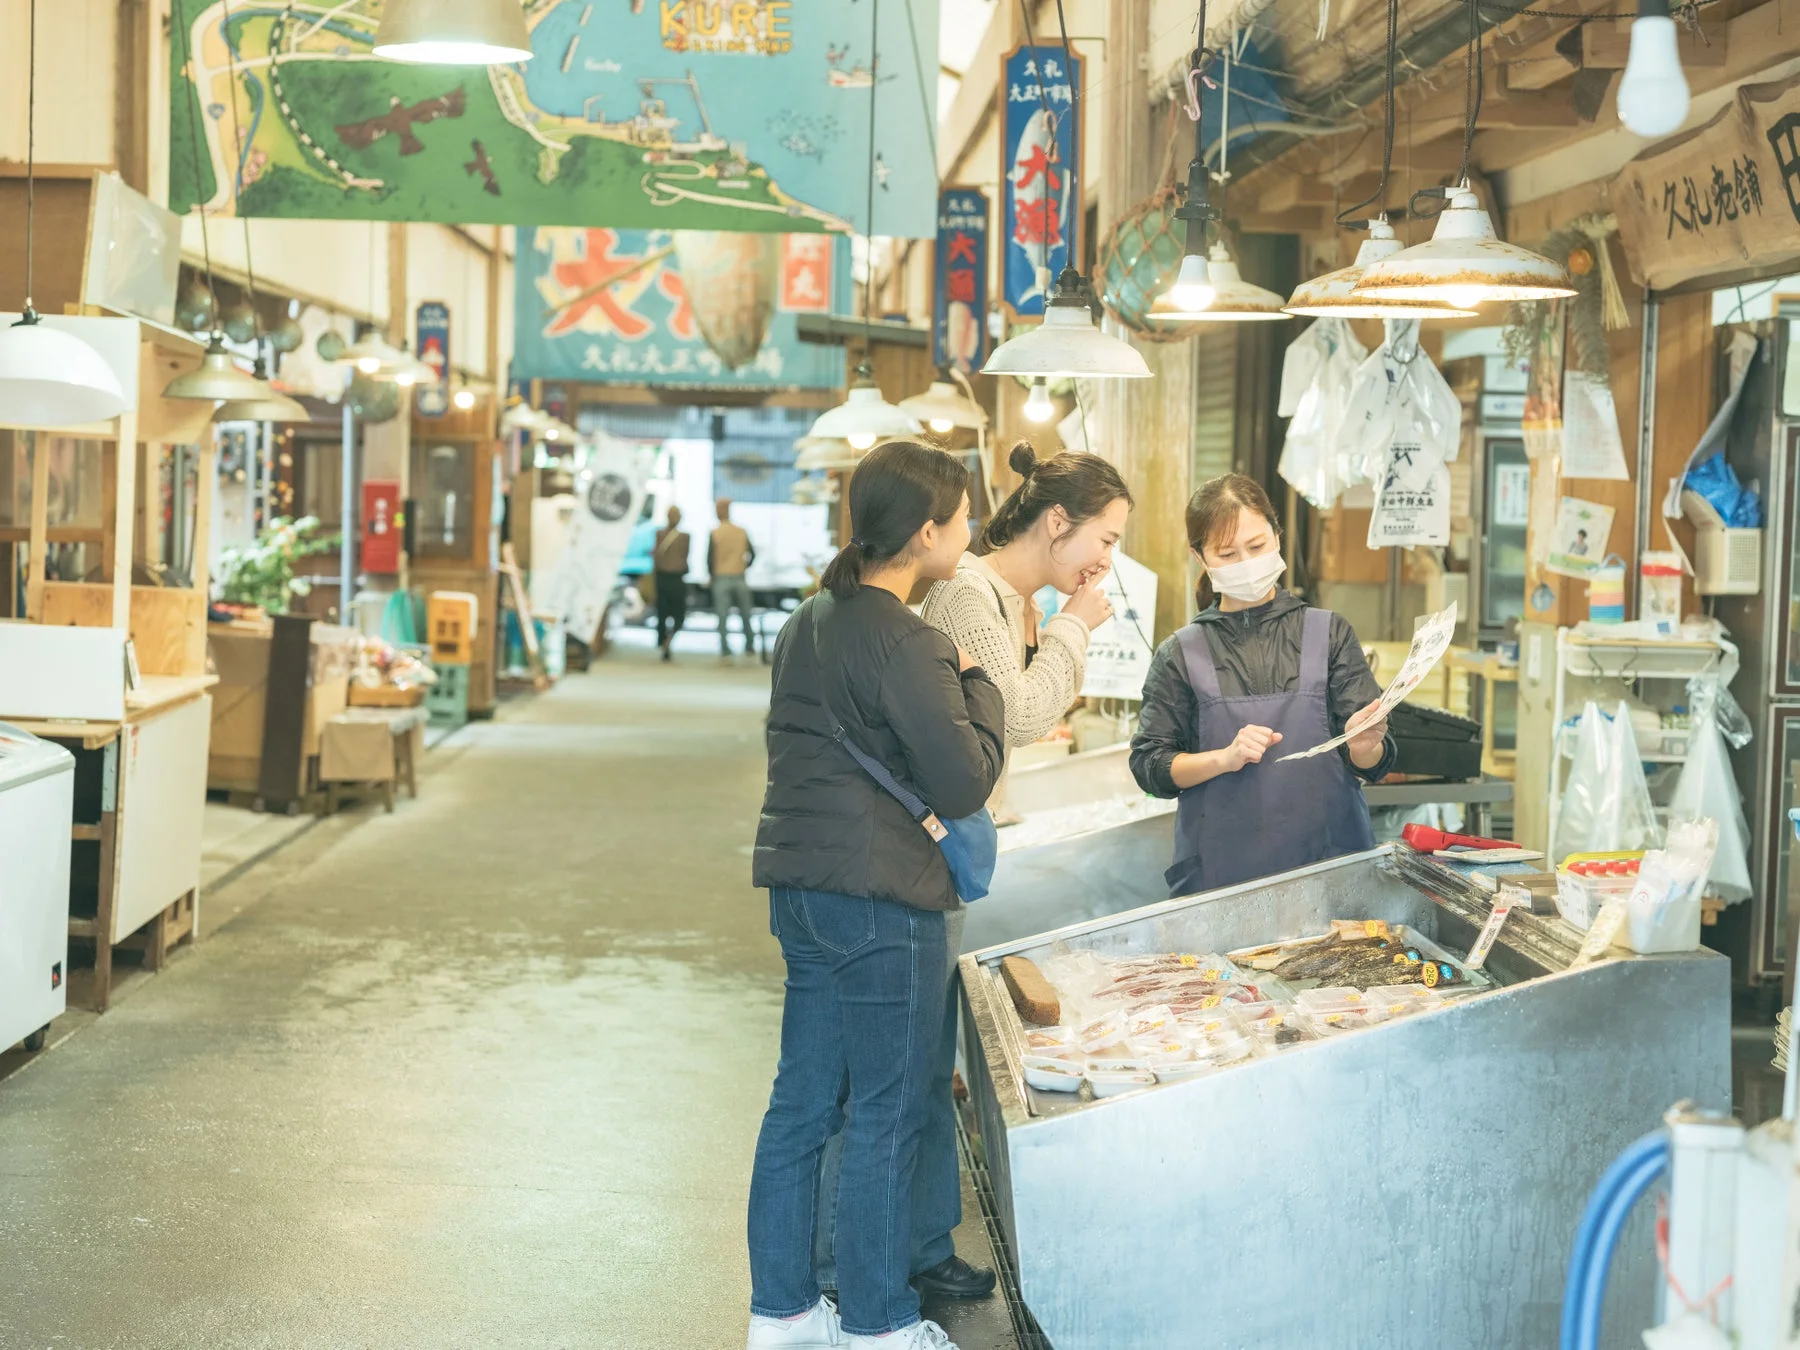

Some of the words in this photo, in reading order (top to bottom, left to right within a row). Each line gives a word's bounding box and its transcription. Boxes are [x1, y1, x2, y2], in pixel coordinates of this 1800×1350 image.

[660, 0, 792, 38] KURE
[1022, 59, 1063, 79] 久礼
[1663, 153, 1763, 240] 久礼老舗
